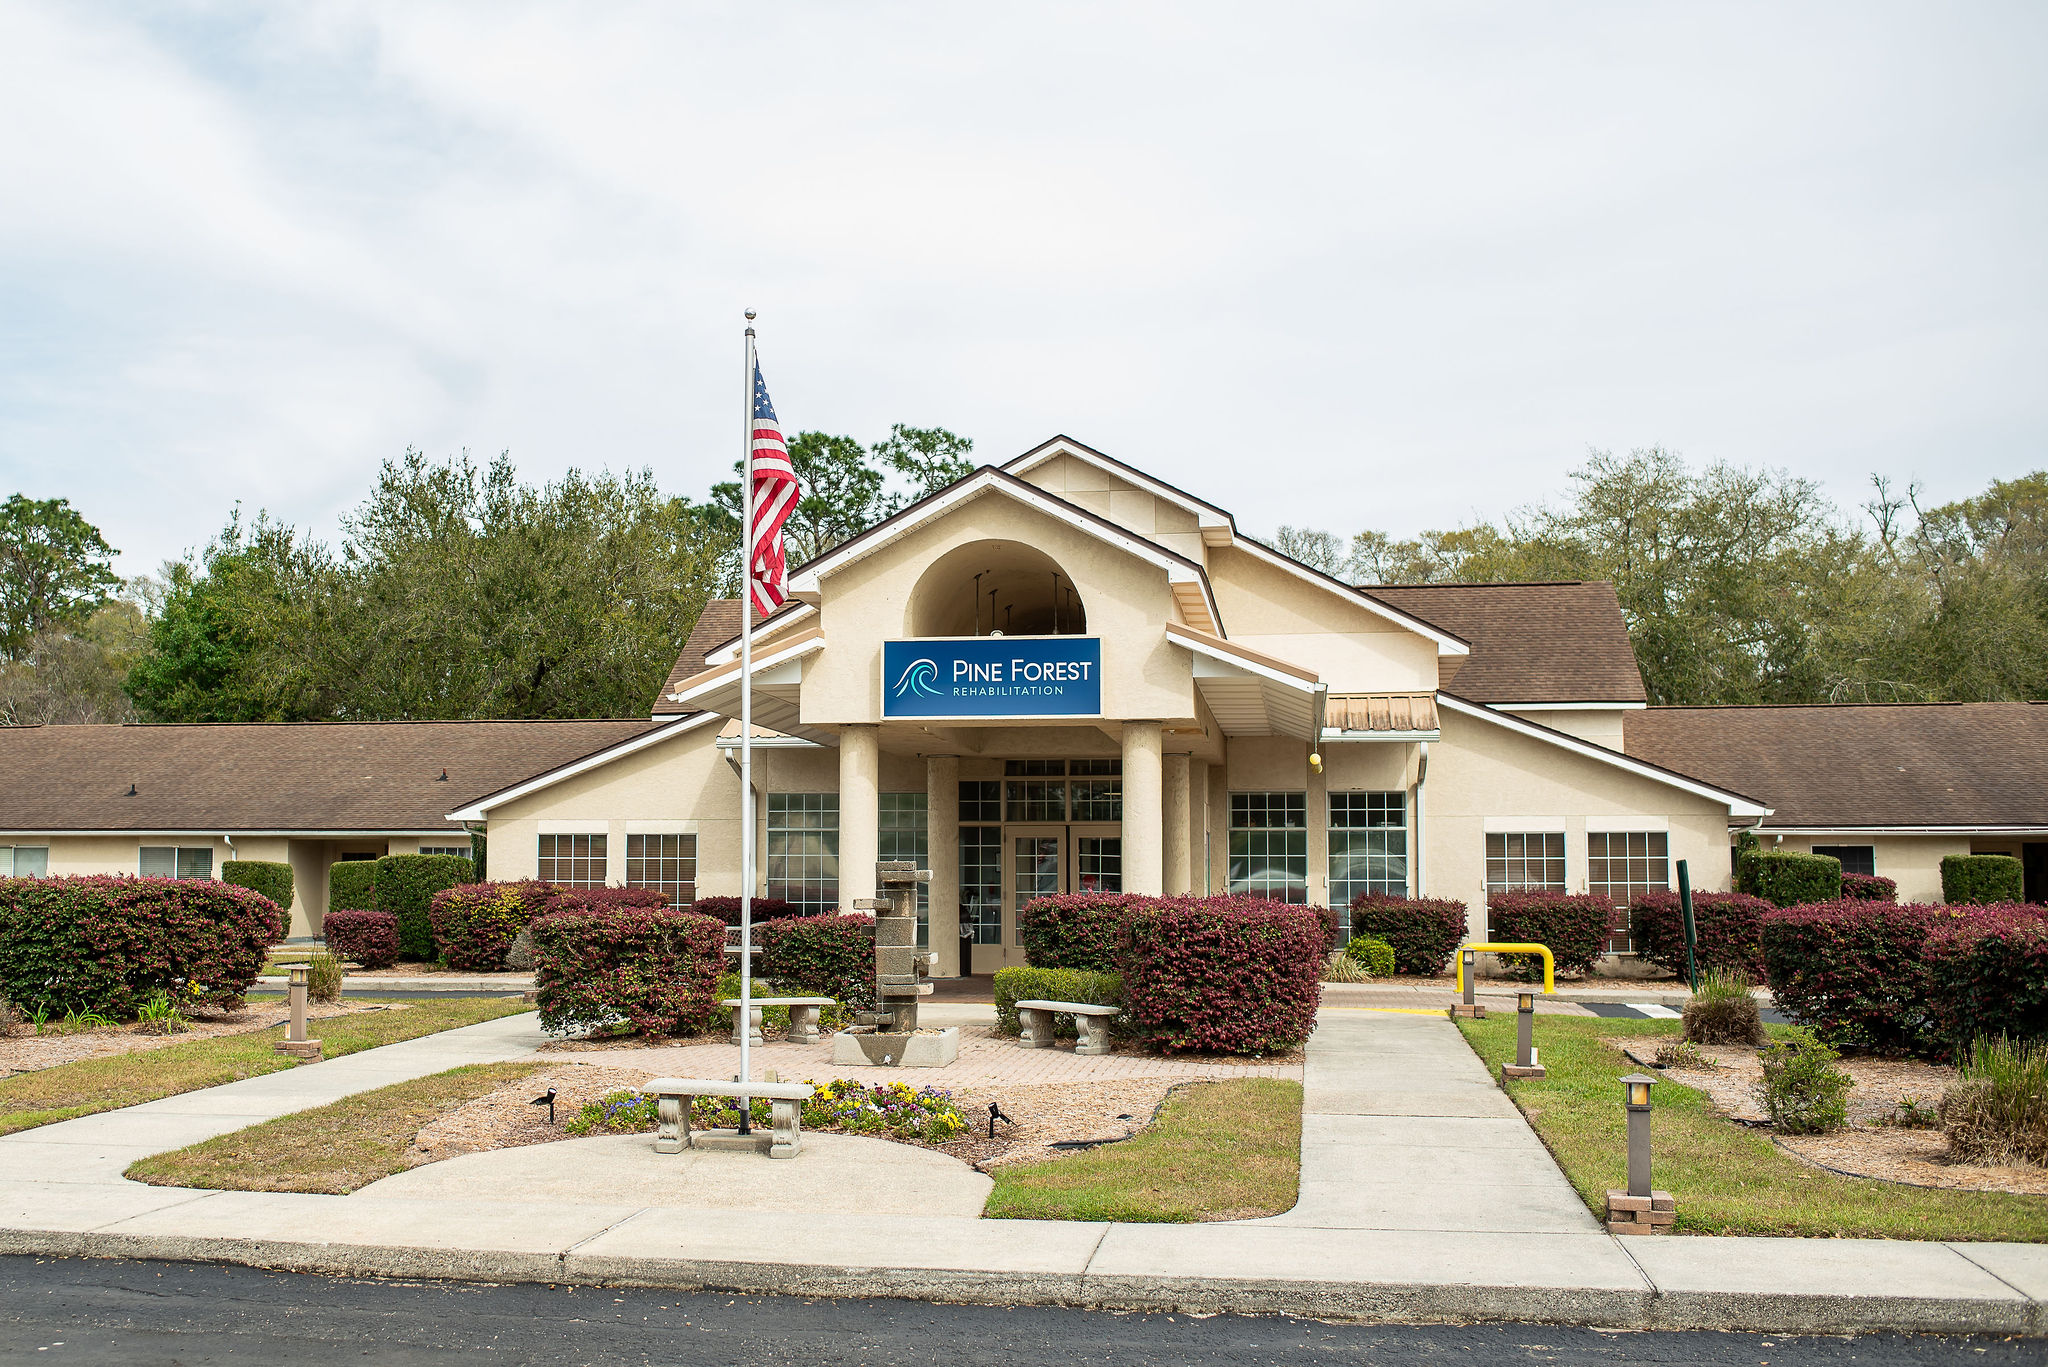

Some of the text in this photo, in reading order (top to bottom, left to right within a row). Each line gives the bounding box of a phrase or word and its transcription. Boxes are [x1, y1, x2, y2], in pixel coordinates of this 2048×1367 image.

[953, 659, 1092, 682] PINE FOREST
[953, 686, 1063, 696] REHABILITATION
